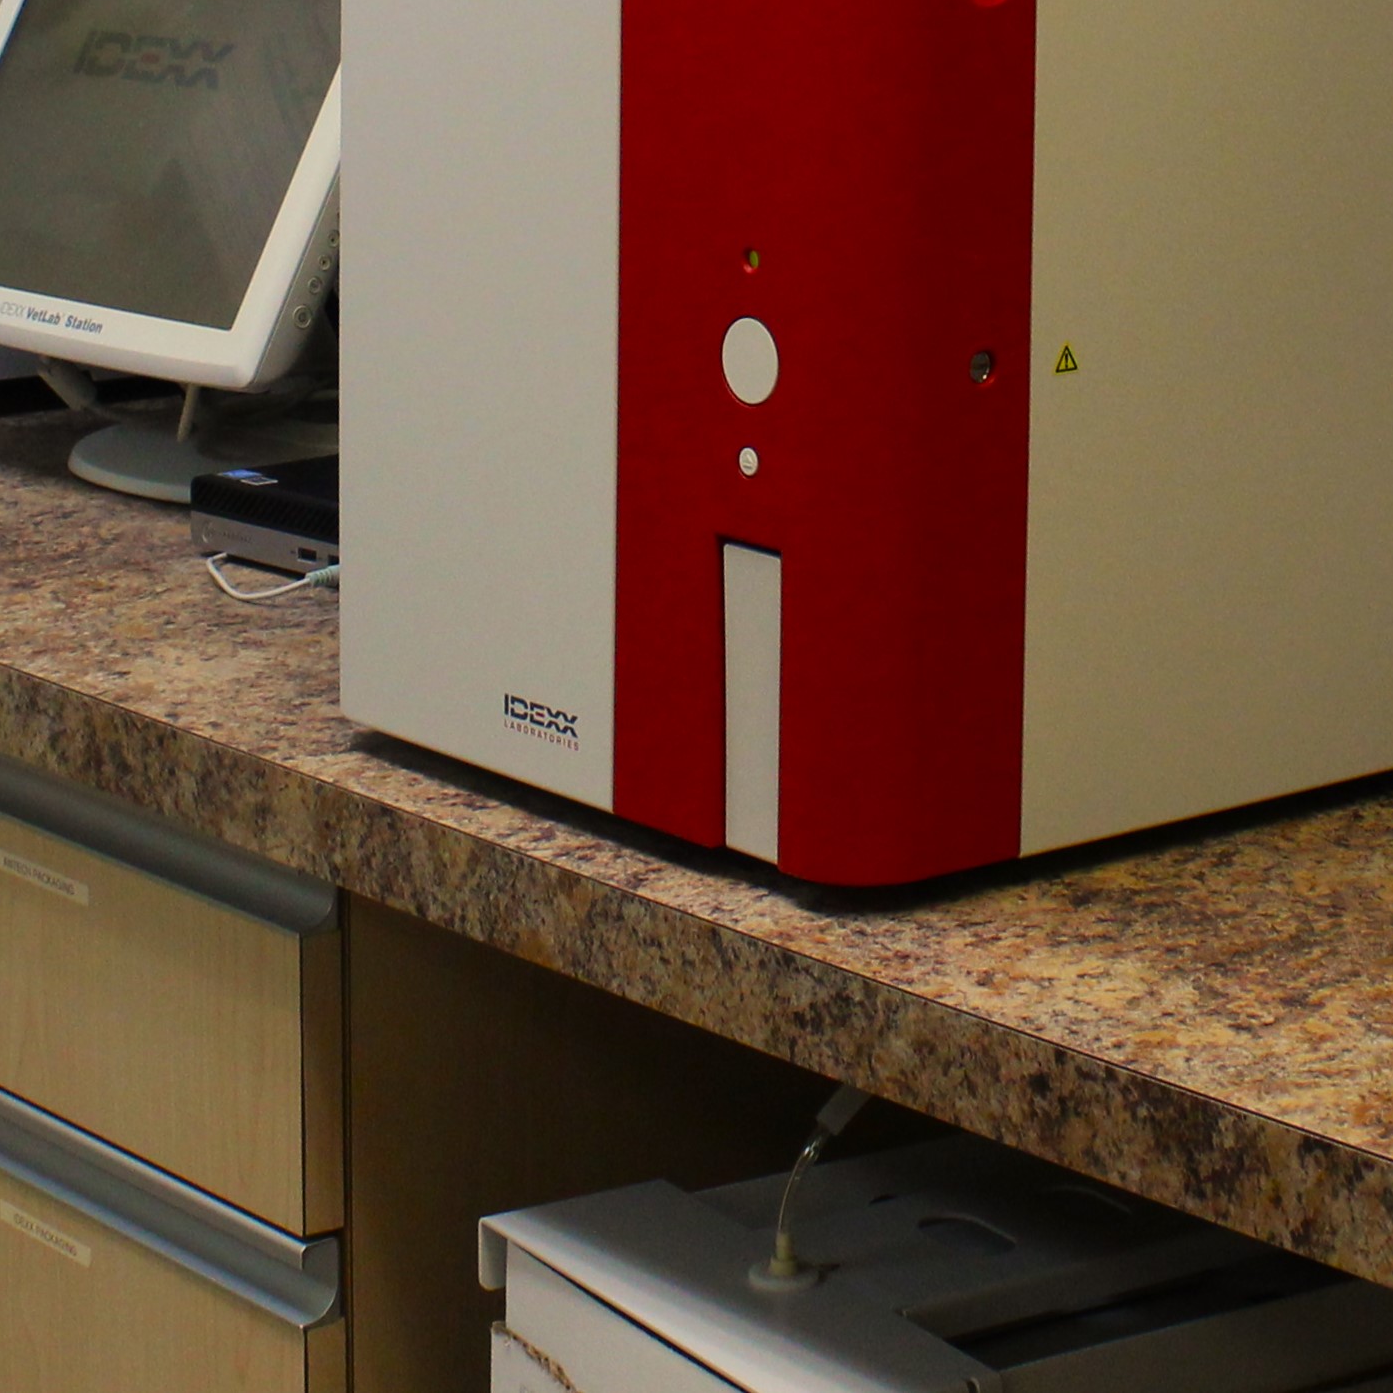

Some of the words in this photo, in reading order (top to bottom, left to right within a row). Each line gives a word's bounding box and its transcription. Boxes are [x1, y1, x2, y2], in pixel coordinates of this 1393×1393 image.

[73, 31, 236, 88] IDEXX
[26, 306, 61, 325] VetLab
[65, 314, 103, 334] Station
[504, 693, 579, 738] IDEXX
[504, 719, 579, 751] LABORATORIES
[32, 867, 76, 897] PACKAGING
